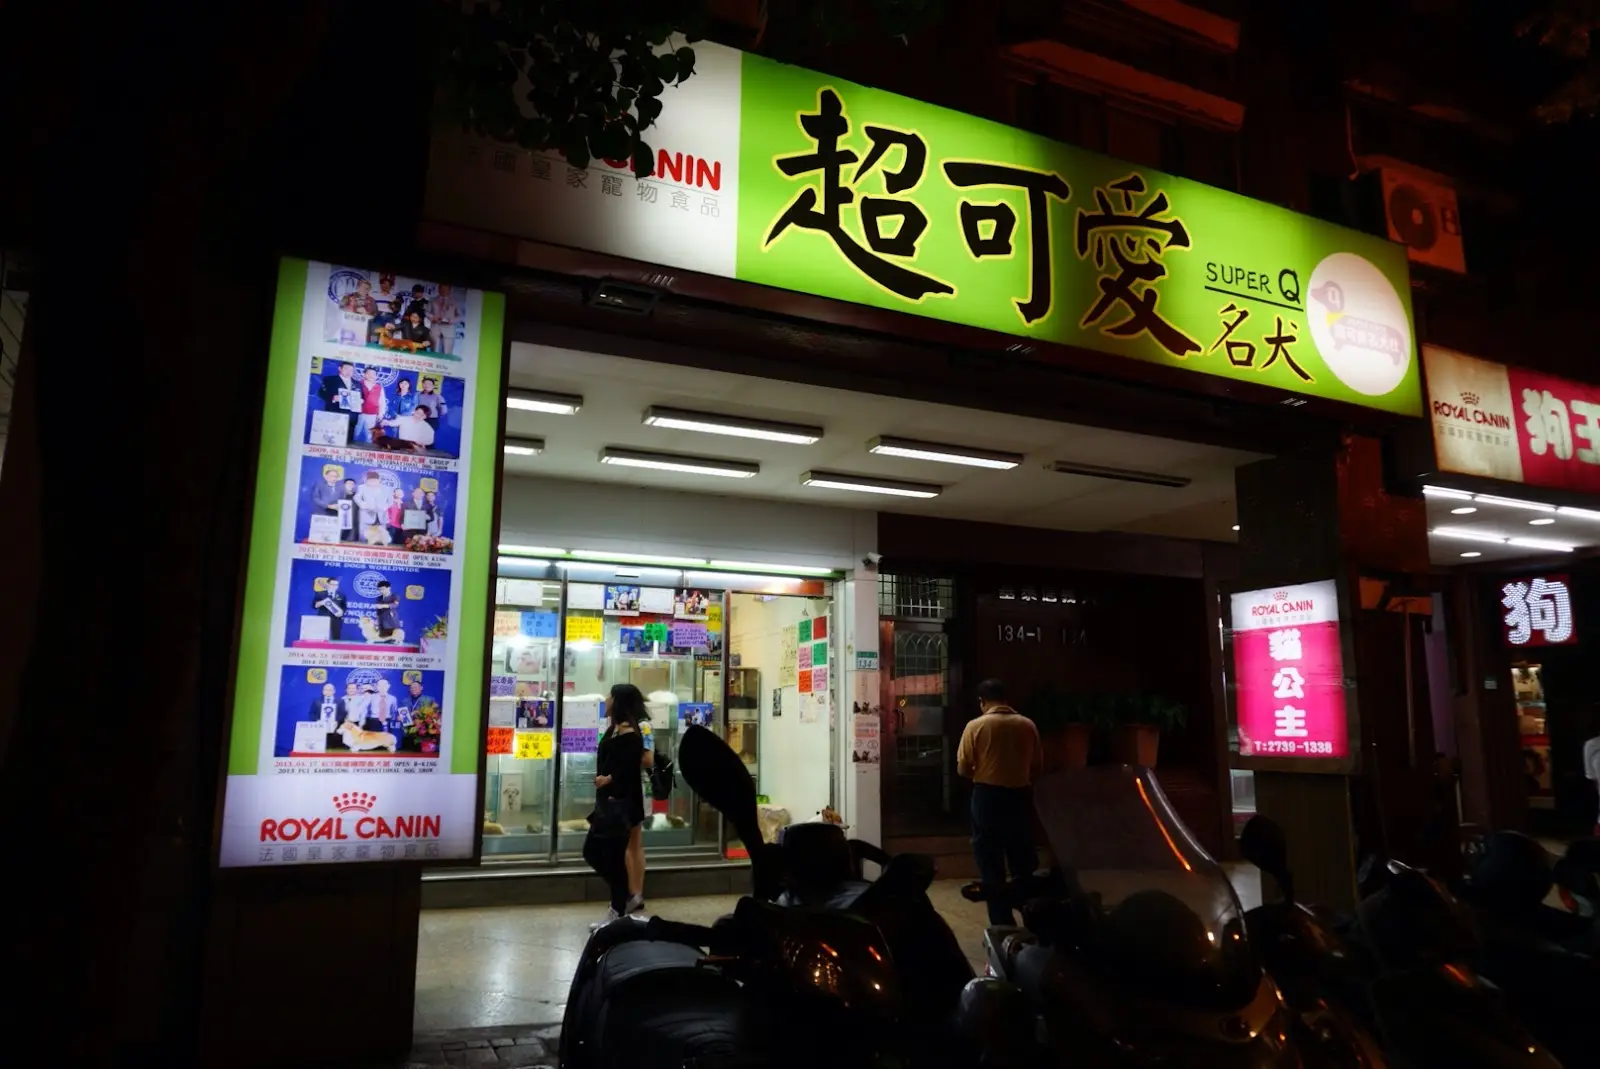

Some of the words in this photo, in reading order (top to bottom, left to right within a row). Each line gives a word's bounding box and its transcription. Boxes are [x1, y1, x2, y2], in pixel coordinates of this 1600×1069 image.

[603, 149, 722, 192] NIN
[764, 87, 1202, 359] 超可愛
[1206, 262, 1271, 295] SUPER
[1278, 268, 1301, 304] Q
[1210, 304, 1314, 381] 名犬
[1434, 401, 1471, 422] ROYAL
[1473, 409, 1510, 430] CANIN
[1252, 603, 1280, 616] ROYAL
[1282, 600, 1313, 612] CANIN
[1501, 578, 1573, 645] 狗
[260, 818, 348, 842] ROYAL
[355, 815, 440, 840] CANIN
